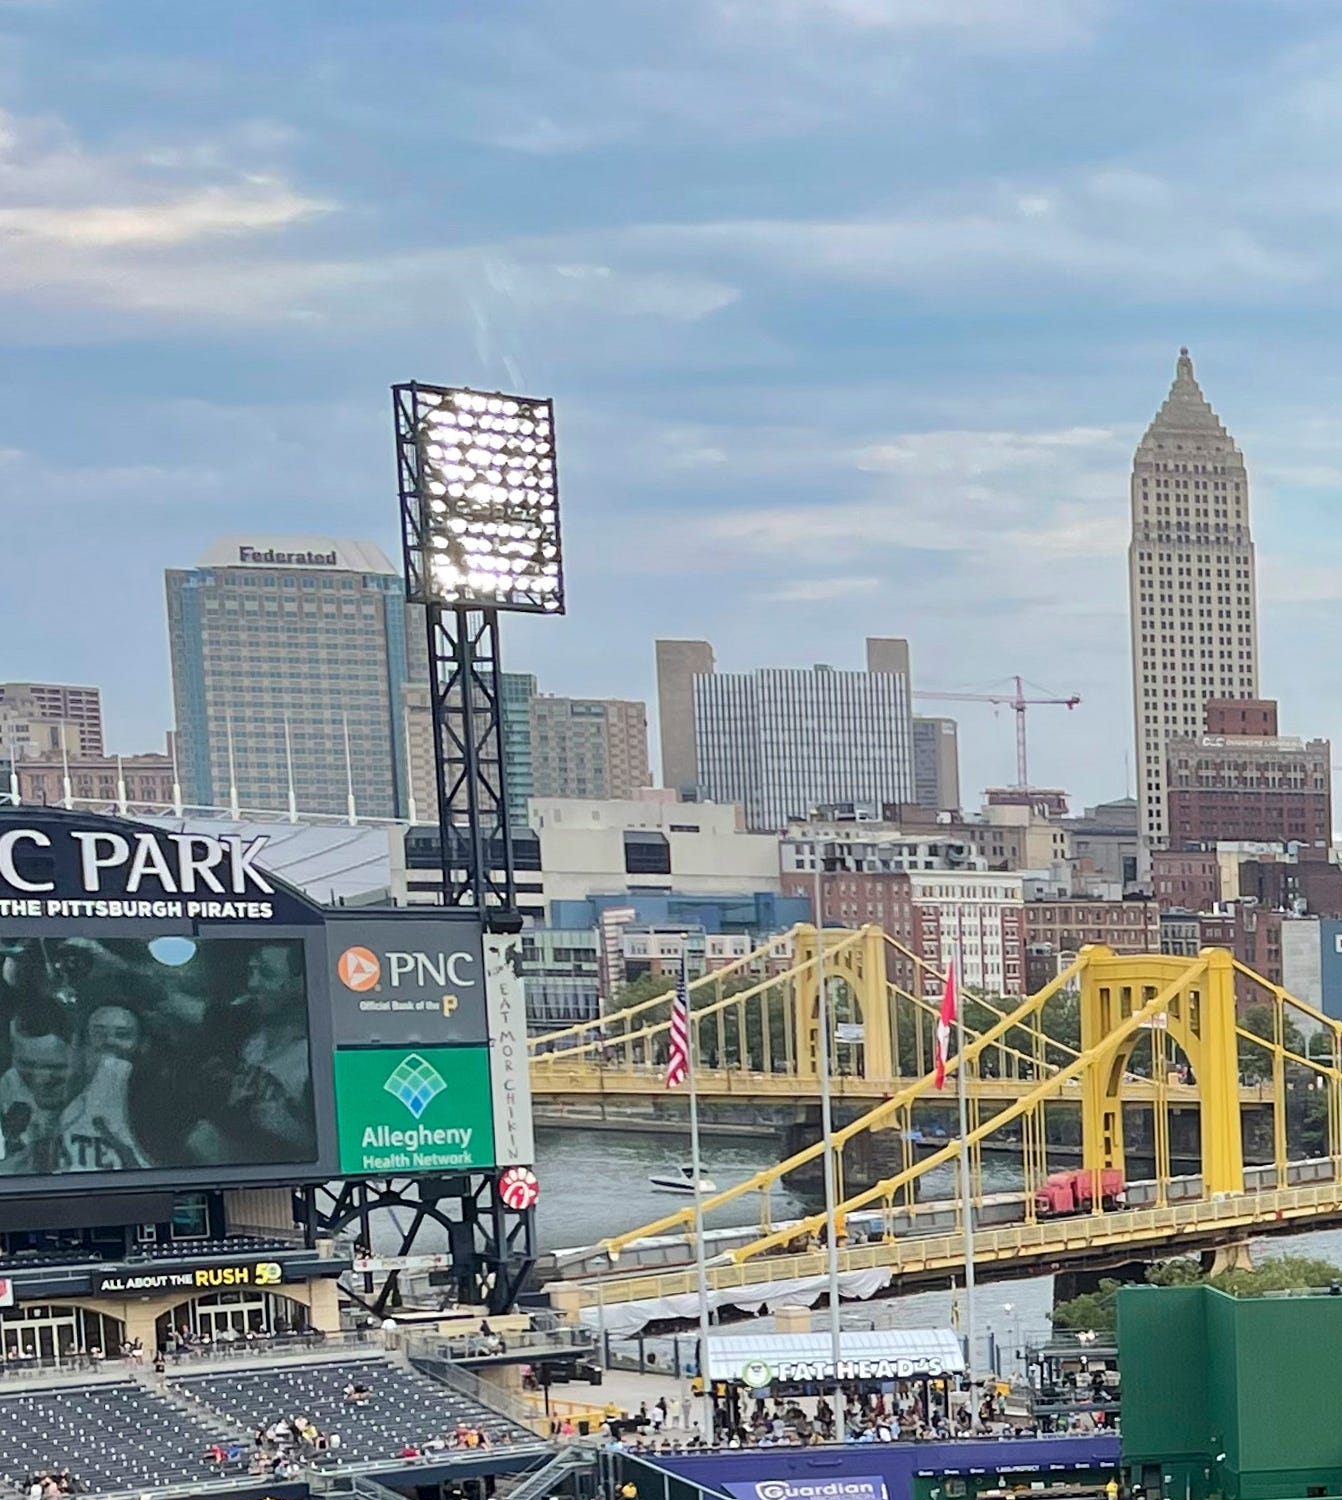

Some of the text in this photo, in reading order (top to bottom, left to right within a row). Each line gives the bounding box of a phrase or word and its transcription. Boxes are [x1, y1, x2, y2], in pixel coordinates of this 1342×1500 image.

[239, 545, 338, 566] Federated
[70, 828, 275, 895] PARK
[0, 899, 274, 919] THE PITTSBURGH PIRATES
[384, 951, 479, 987] PNC
[361, 1124, 473, 1152] Allegheny
[362, 1151, 474, 1169] Health Network
[101, 1278, 124, 1291] ALL
[125, 1274, 169, 1290] ABOUT
[169, 1272, 193, 1286] THE
[194, 1266, 248, 1287] RUSH
[778, 1357, 942, 1381] FAT HEAD'S
